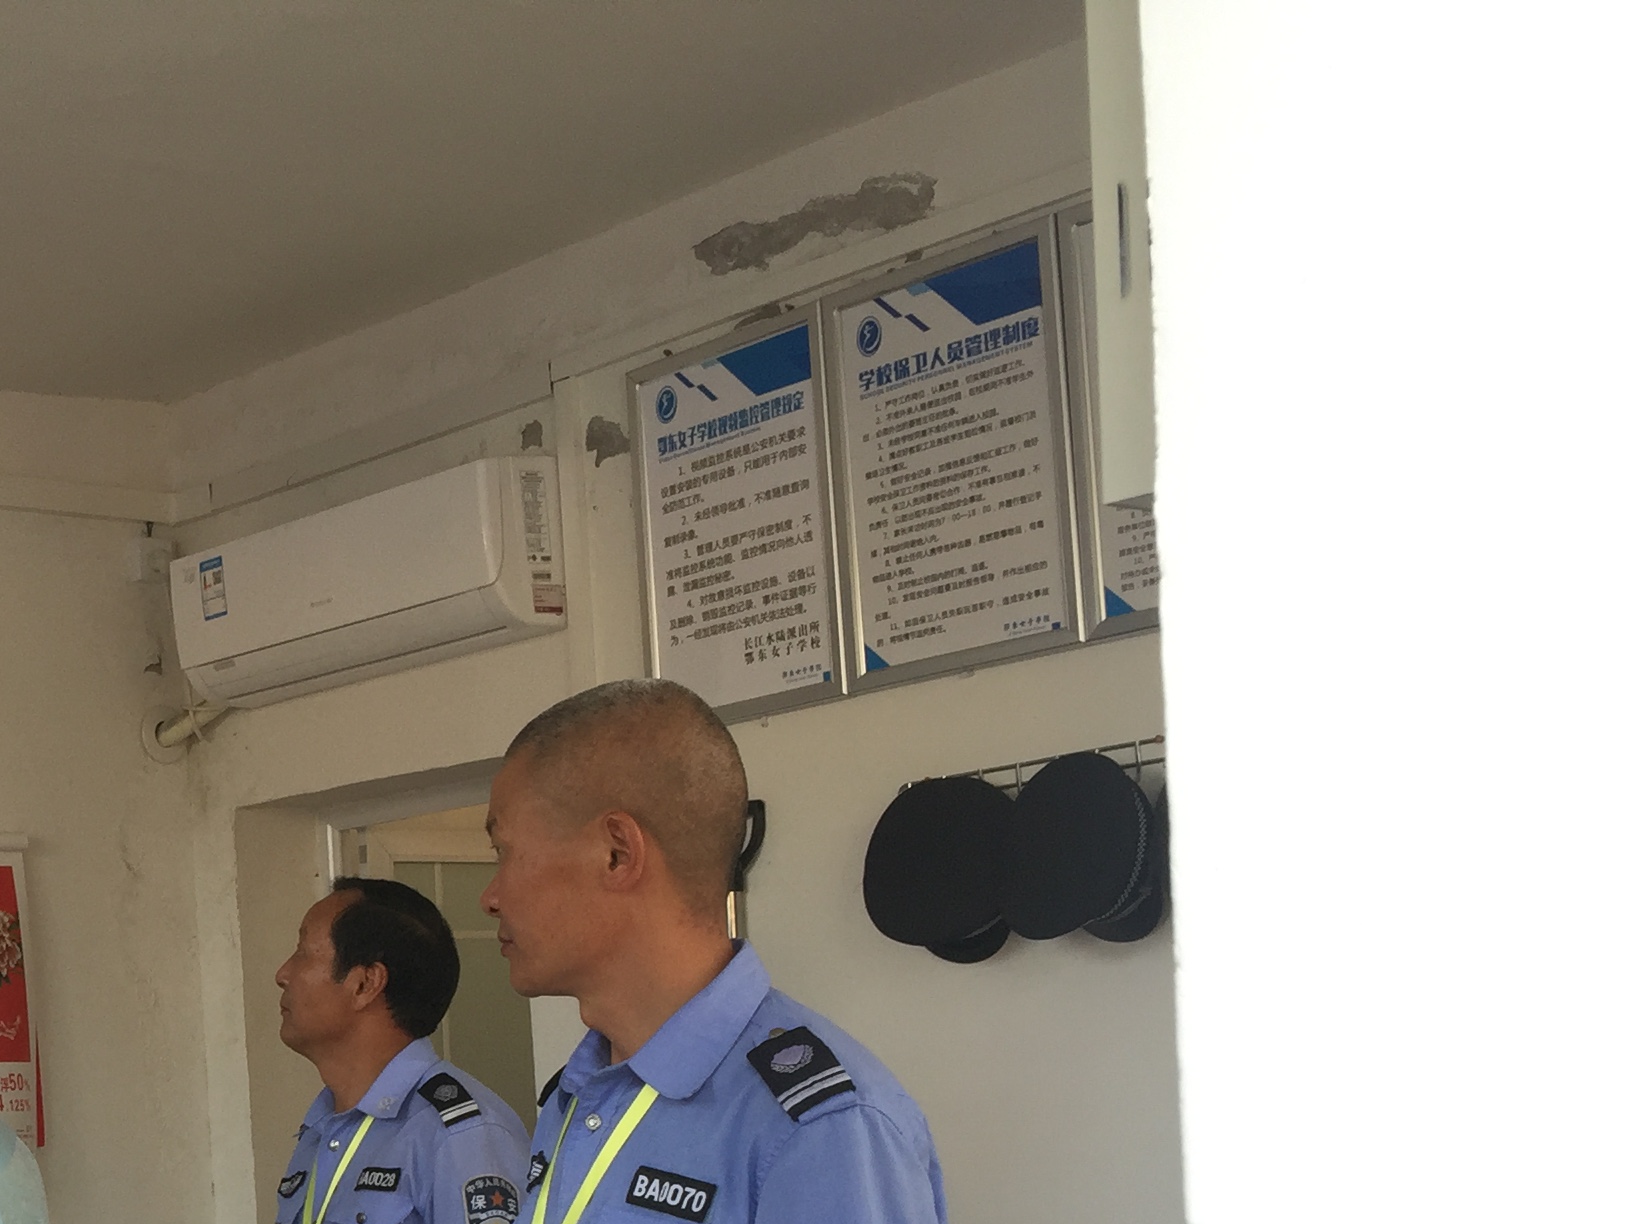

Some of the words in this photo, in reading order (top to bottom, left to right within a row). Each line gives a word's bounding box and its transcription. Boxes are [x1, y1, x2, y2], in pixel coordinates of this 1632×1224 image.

[859, 316, 1040, 391] 学校保卫人员管理制度
[657, 390, 805, 457] 鄂东女子学校视频监控管理规定
[744, 635, 821, 665] 鄂东女子学校
